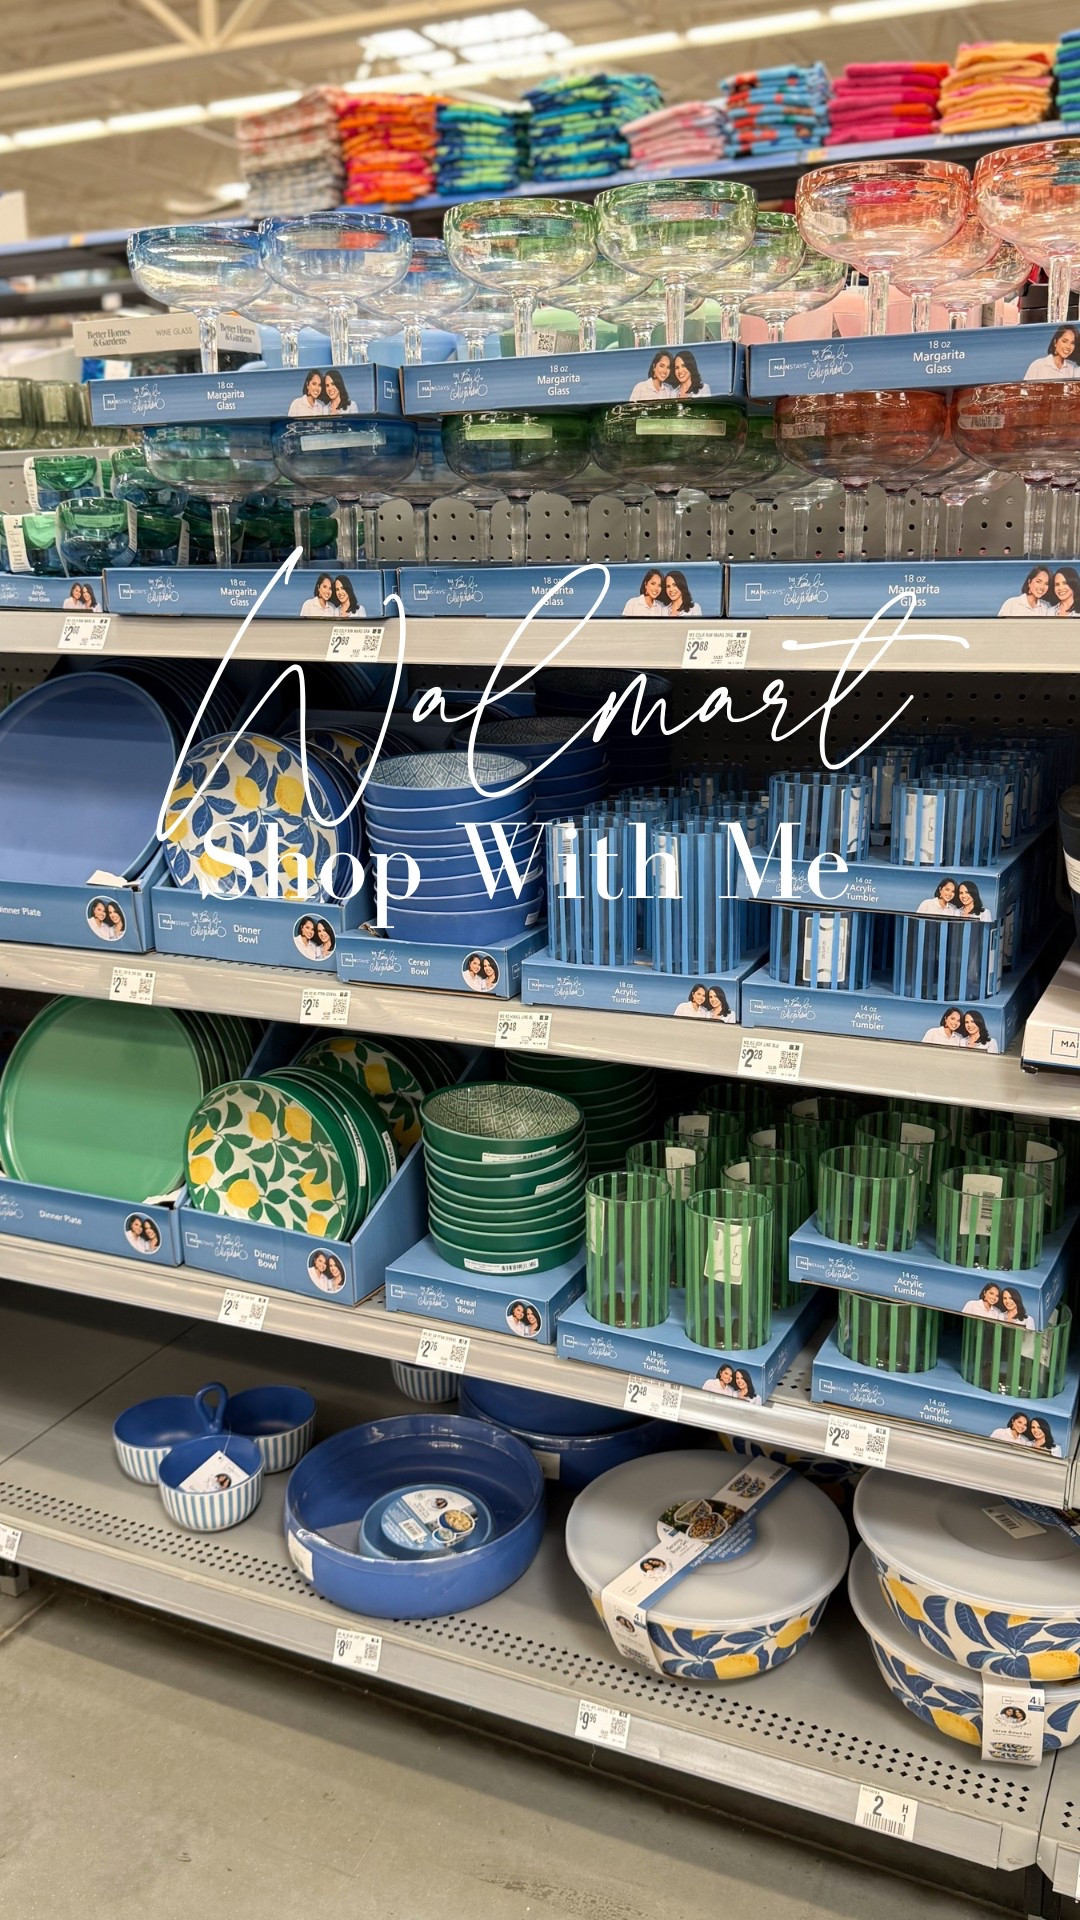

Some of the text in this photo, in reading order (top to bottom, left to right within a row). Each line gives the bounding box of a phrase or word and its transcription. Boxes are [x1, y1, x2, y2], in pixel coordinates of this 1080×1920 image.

[108, 328, 131, 337] Homes
[174, 327, 193, 336] GLASS
[929, 340, 939, 348] 18
[913, 350, 966, 362] Margarita
[550, 365, 558, 373] 18
[926, 364, 952, 374] Glass
[537, 374, 581, 387] Margarita
[548, 386, 570, 396] Glass
[207, 390, 245, 403] Margarita
[216, 402, 236, 411] Glass
[220, 588, 257, 598] Margarita
[532, 586, 574, 596] Mararita
[230, 598, 249, 607] Glass
[900, 597, 926, 607] Glss
[850, 885, 876, 893] Acrylic
[846, 893, 879, 902] Tumbler
[22, 908, 42, 916] Plate
[234, 924, 261, 935] Dinner
[238, 935, 258, 944] Bowl
[408, 958, 431, 967] Cereal
[411, 967, 429, 976] Bowl
[615, 988, 637, 997] Acrylic
[611, 996, 640, 1005] Tumbler
[855, 1012, 881, 1021] Acrylic
[851, 1021, 885, 1030] Tumbler
[39, 1210, 62, 1221] Dinner
[254, 1249, 279, 1262] Dinner
[258, 1259, 277, 1270] Bowl
[897, 1278, 923, 1288] Acrylic
[894, 1286, 926, 1298] Tumbler
[455, 1297, 477, 1308] Cereal
[458, 1305, 474, 1315] Bowl
[645, 1356, 667, 1367] Acrylic
[643, 1362, 670, 1374] Tumbler
[924, 1405, 950, 1416] Acrylic
[920, 1412, 952, 1424] Tumbler
[1030, 1696, 1036, 1704] 4
[872, 1795, 884, 1816] 2
[902, 1804, 908, 1814] H
[902, 1814, 906, 1822] 1
